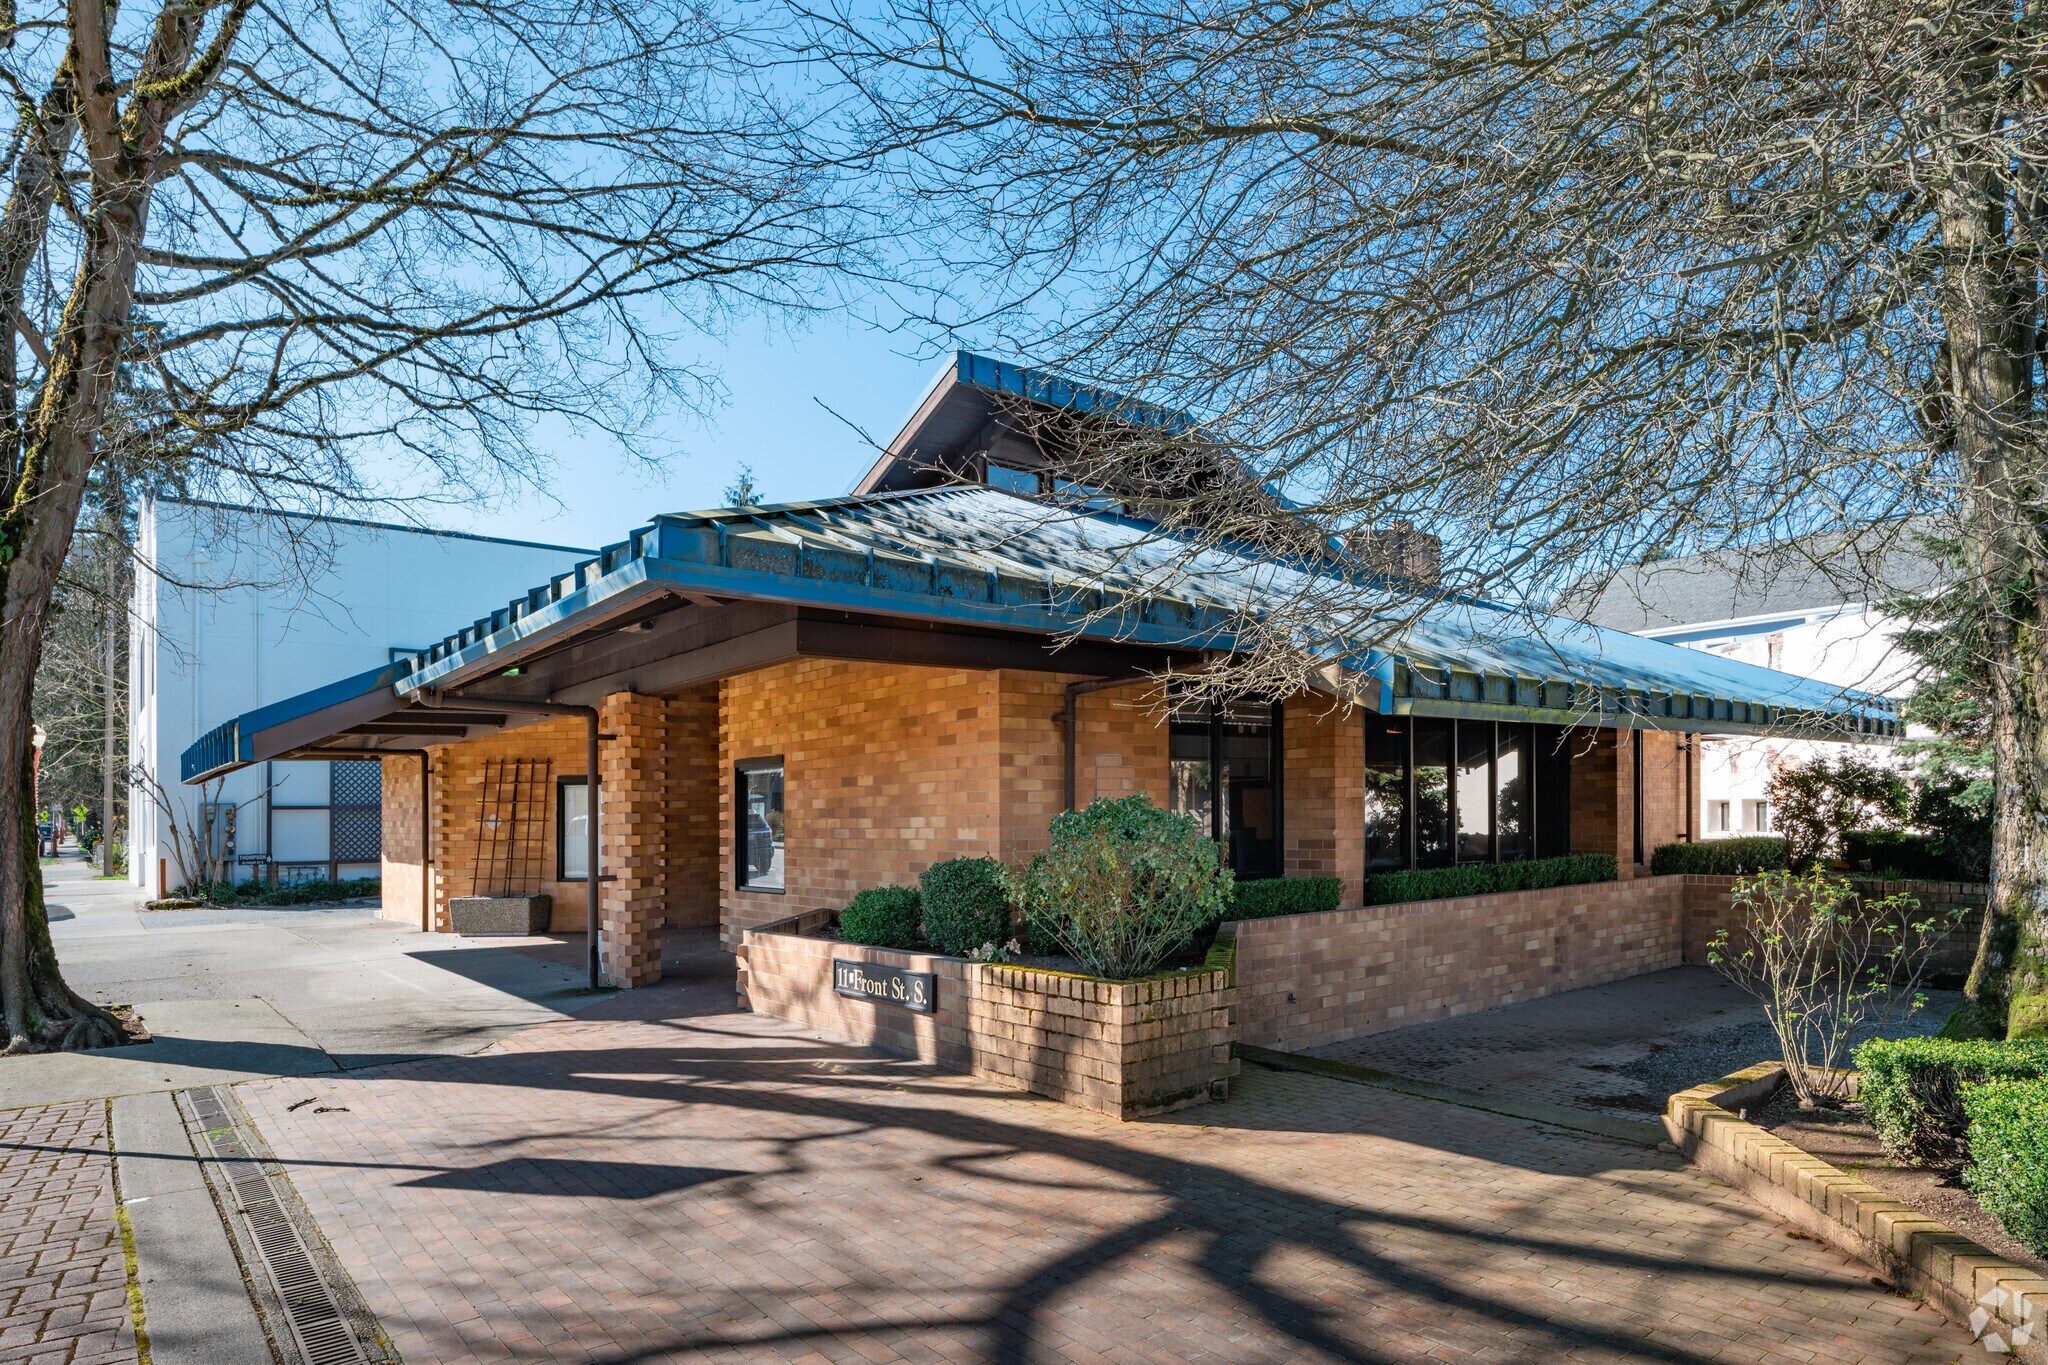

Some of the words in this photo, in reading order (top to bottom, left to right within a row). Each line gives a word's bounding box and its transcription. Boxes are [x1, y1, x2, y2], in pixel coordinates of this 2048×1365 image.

[838, 968, 849, 988] 11
[853, 968, 888, 997] Front
[892, 976, 910, 1002] St.
[914, 980, 928, 1005] S.
